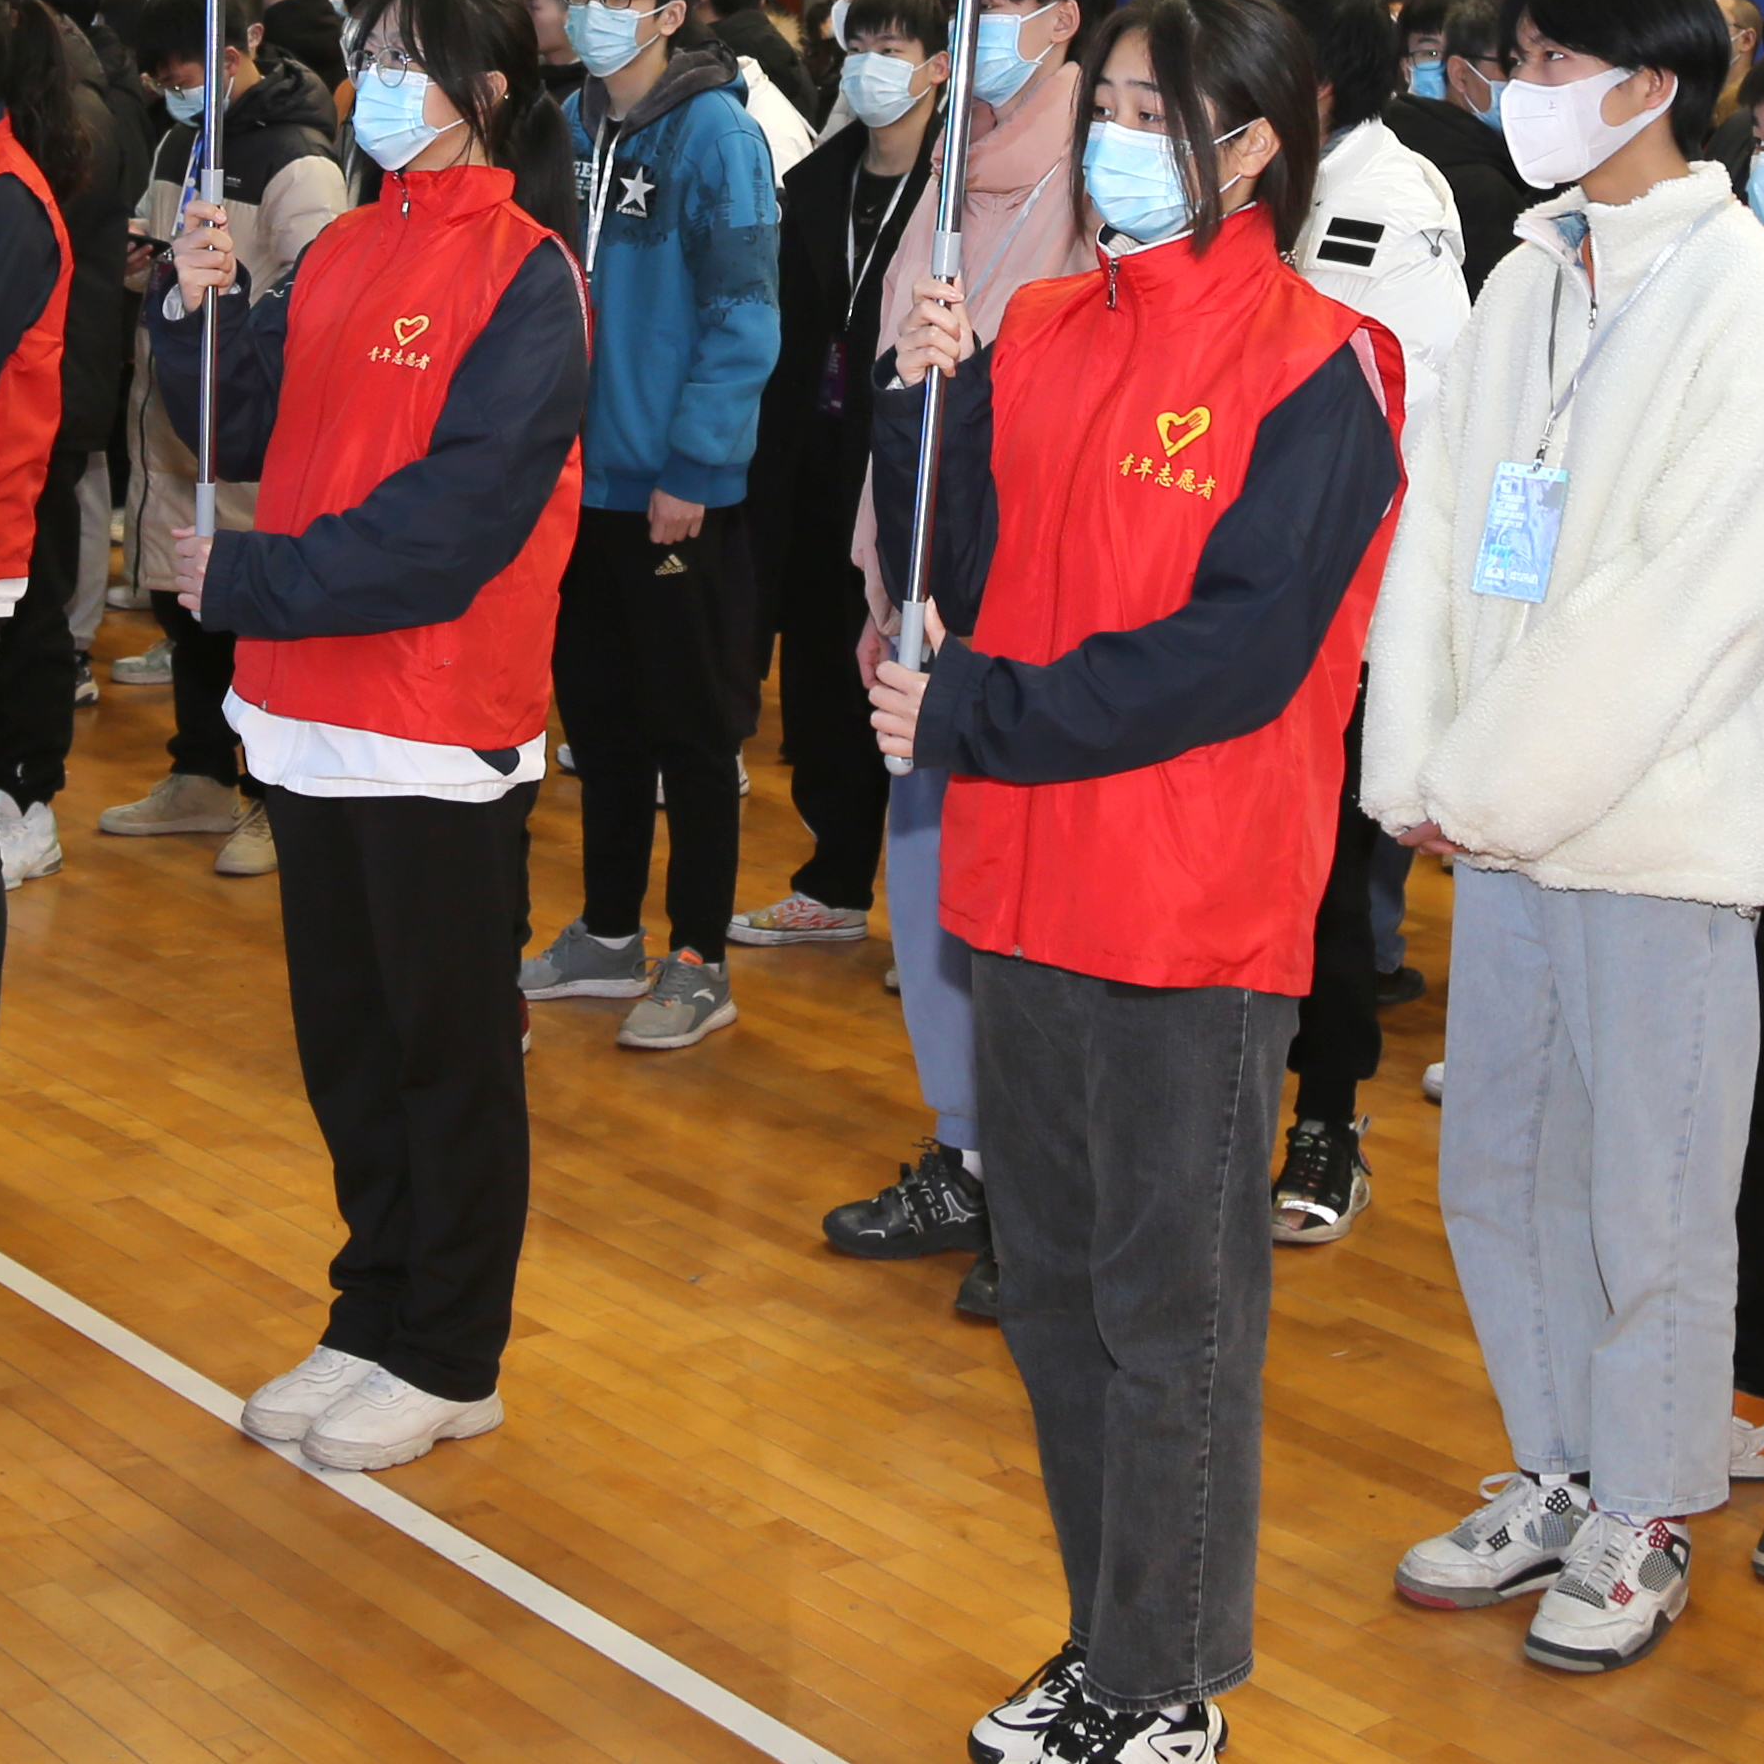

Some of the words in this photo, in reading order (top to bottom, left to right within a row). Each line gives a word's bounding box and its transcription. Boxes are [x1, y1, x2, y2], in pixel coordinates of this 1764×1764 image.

[1118, 453, 1217, 500] 青年志愿者
